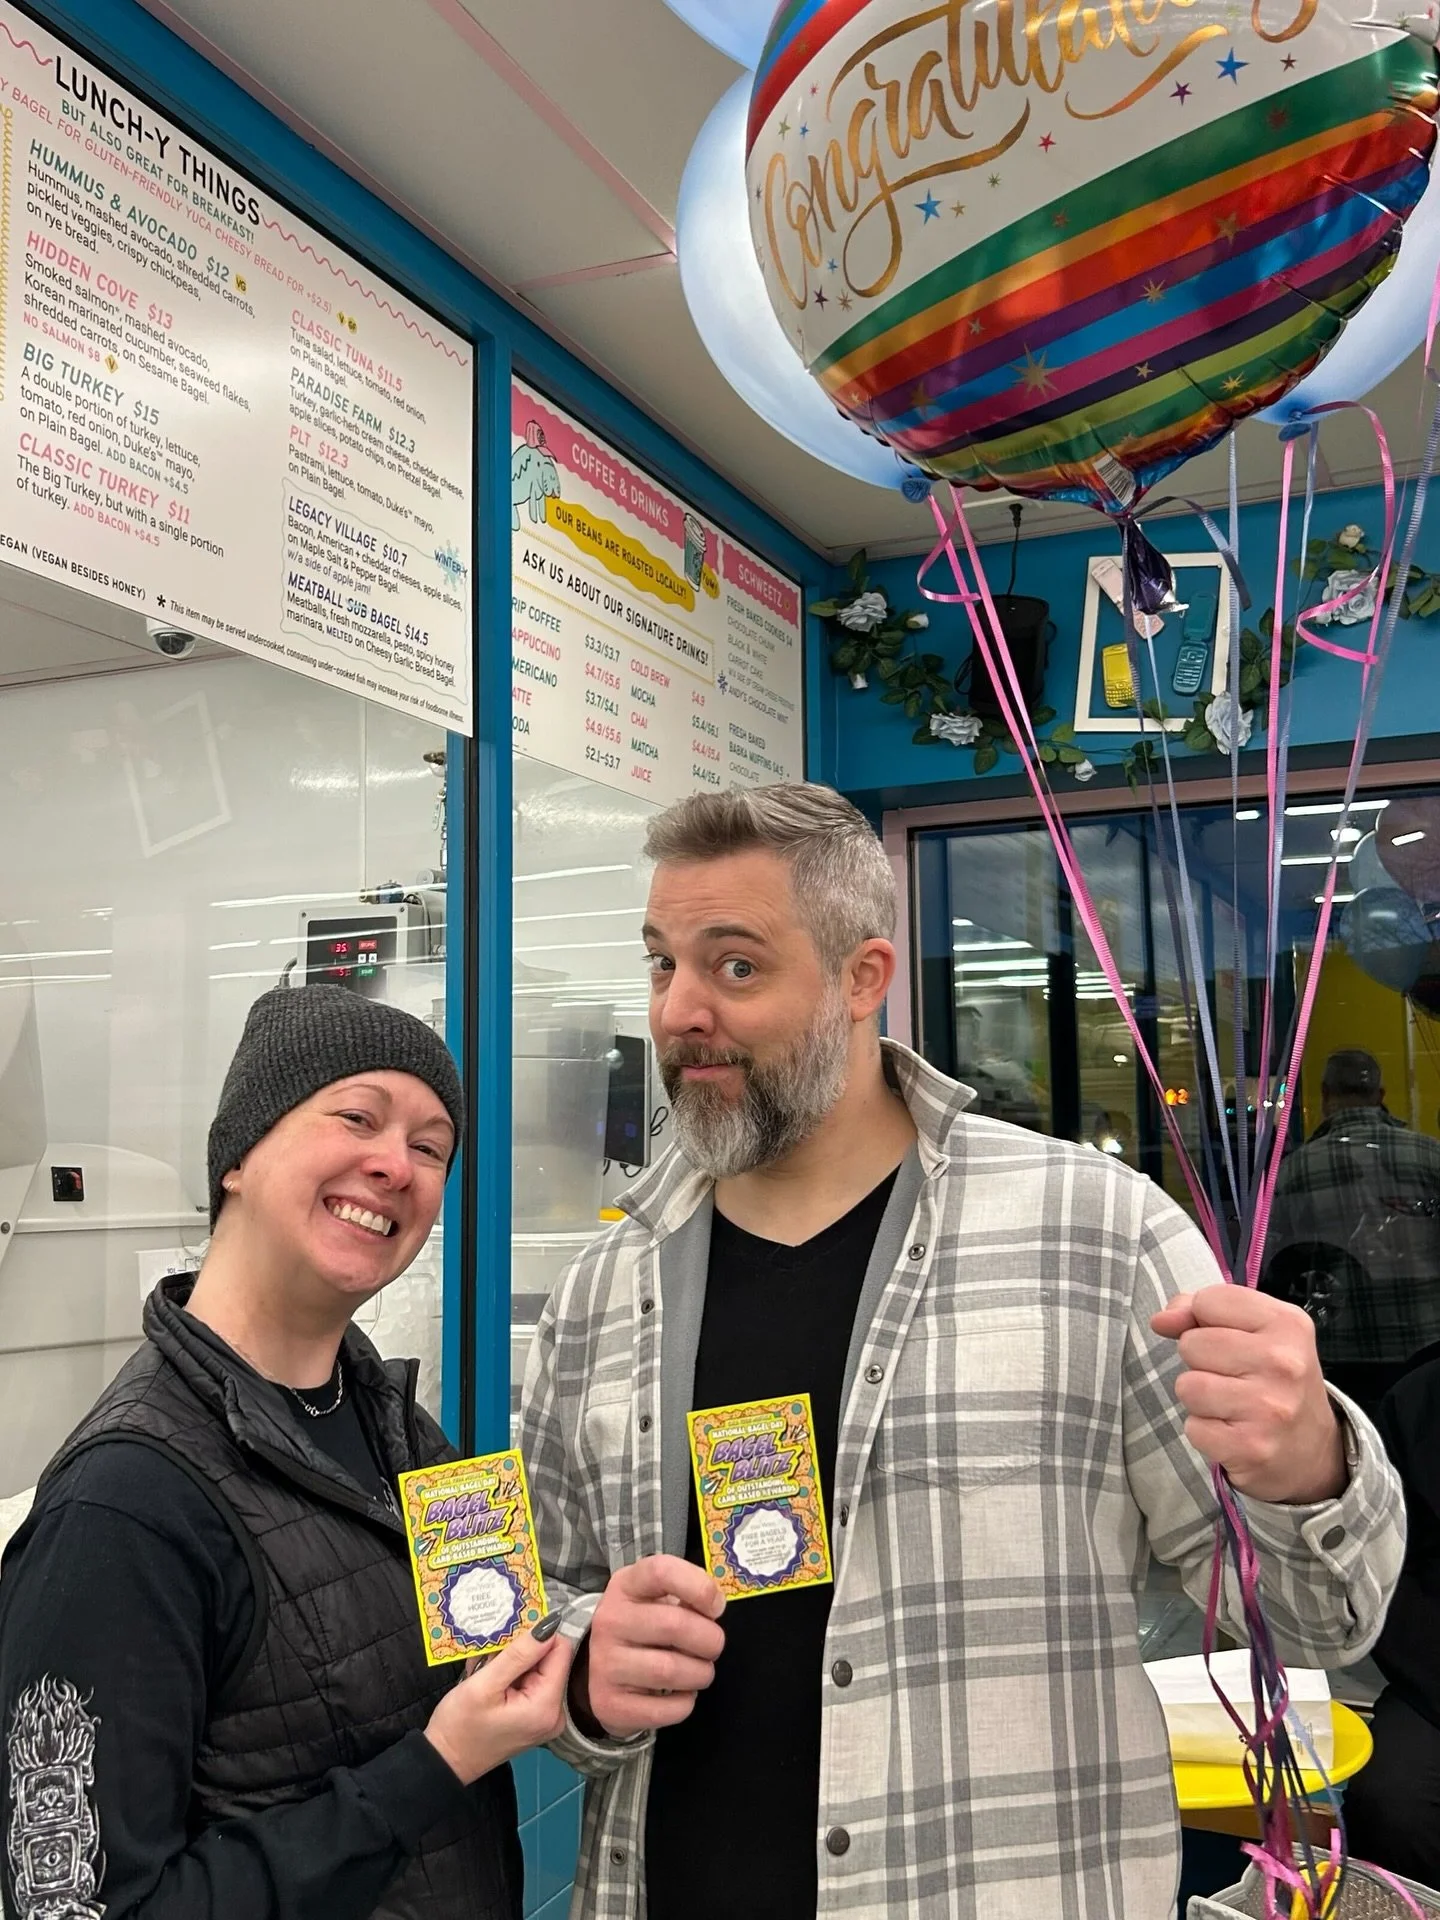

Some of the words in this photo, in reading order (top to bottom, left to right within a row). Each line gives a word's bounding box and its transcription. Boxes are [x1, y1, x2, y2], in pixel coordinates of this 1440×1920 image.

[56, 55, 170, 159] LUNCH-Y
[178, 144, 259, 225] THINGS
[61, 98, 86, 126] BUT
[89, 120, 122, 152] ALSO
[126, 145, 163, 180] GREAT
[167, 173, 189, 199] FOR
[192, 190, 254, 244] BREAKFAST!
[11, 86, 53, 125] BAGEL
[57, 117, 82, 144] FOR
[84, 137, 183, 212] GLUTEN-FRIENDLY
[185, 205, 211, 233] YUCA
[215, 227, 252, 259] CHEESY
[253, 253, 284, 281] BREAD
[286, 275, 304, 295] FOR
[26, 201, 42, 219] on
[44, 211, 62, 231] rye
[65, 220, 99, 254] bread.
[30, 138, 105, 200] HUMMUS
[109, 193, 121, 213] &
[126, 205, 197, 260] AVOCADO
[206, 256, 229, 283] $12
[27, 181, 69, 216] pickled
[70, 209, 115, 247] veggies,
[117, 239, 148, 268] crispy
[150, 260, 201, 301] chickpeas,
[28, 159, 83, 209] Hummus,
[85, 200, 128, 236] mashed
[130, 229, 175, 268] avocado,
[177, 259, 220, 295] shredded
[222, 289, 255, 319] carrots,
[24, 252, 72, 291] Smoked
[124, 313, 165, 345] mashed
[167, 338, 210, 372] avocado,
[27, 230, 91, 282] HIDDEN
[96, 273, 139, 310] COVE
[147, 303, 173, 330] $13
[23, 311, 38, 329] NO
[41, 321, 85, 354] SALMON
[87, 346, 100, 362] $8
[24, 292, 77, 332] shredded
[80, 324, 120, 357] carrots,
[122, 348, 136, 364] on
[138, 354, 178, 387] Sesame
[24, 270, 65, 306] Korean
[68, 298, 123, 339] marinated
[124, 331, 177, 371] cucumber,
[179, 362, 220, 394] seaweed
[222, 384, 250, 412] flakes,
[292, 309, 342, 352] CLASSIC
[346, 343, 374, 374] TUNA
[377, 364, 402, 392] $11.5
[21, 365, 30, 381] A
[33, 371, 72, 402] double
[74, 394, 114, 423] portion
[116, 415, 128, 429] of
[129, 420, 163, 449] turkey,
[165, 437, 200, 468] lettuce,
[23, 342, 54, 371] BIG
[61, 360, 124, 407] TURKEY
[133, 400, 159, 426] $15
[290, 366, 350, 414] PARADISE
[351, 403, 382, 434] FARM
[388, 426, 415, 454] $12.3
[19, 406, 35, 422] on
[38, 411, 67, 437] Plain
[69, 426, 103, 454] Bagel.
[106, 446, 126, 464] ADD
[129, 457, 161, 482] BACON
[163, 476, 189, 495] +$4.5
[20, 384, 65, 419] tomato,
[67, 409, 86, 427] red
[88, 420, 121, 447] onion,
[165, 458, 195, 482] mayo,
[289, 424, 311, 448] PLT
[318, 440, 349, 469] $12.3
[16, 476, 29, 491] of
[31, 481, 70, 510] turkey.
[73, 501, 95, 519] ADD
[97, 510, 131, 535] BACON
[134, 528, 160, 547] +$4.5
[17, 453, 40, 477] The
[42, 465, 61, 489] Big
[63, 474, 103, 507] Turkey,
[105, 493, 123, 514] but
[125, 505, 147, 524] with
[149, 516, 156, 528] a
[158, 520, 188, 542] single
[190, 534, 224, 557] portion
[20, 432, 93, 479] CLASSIC
[98, 467, 159, 509] TURKEY
[168, 500, 189, 525] $11
[571, 445, 615, 489] COFFEE
[619, 479, 627, 497] &
[630, 487, 669, 526] DRINKS
[288, 495, 332, 529] LEGACY
[335, 518, 377, 553] VILLAGE
[382, 543, 407, 567] $10.7
[555, 505, 573, 528] OUR
[576, 518, 603, 546] BEANS
[604, 538, 620, 557] ARE
[621, 547, 654, 578] ROASTED
[655, 570, 686, 599] LOCALLY!
[32, 546, 68, 570] (VEGAN
[70, 561, 109, 586] BESIDES
[112, 578, 146, 601] HONEY)
[288, 571, 343, 609] MEATBALL
[346, 597, 367, 619] SUB
[370, 608, 401, 635] BAGEL
[404, 623, 428, 646] $14.5
[522, 549, 546, 575] ASK
[549, 562, 564, 584] US
[566, 573, 601, 604] ABOUT
[603, 594, 623, 618] OUR
[625, 607, 674, 647] SIGNATURE
[676, 636, 708, 666] DRINKS!
[738, 565, 783, 607] SCHWEETZ
[528, 605, 561, 633] COFFEE
[585, 634, 620, 662] $3.3/$3.7
[585, 661, 620, 690] $4.7/$5.6
[585, 689, 619, 716] $3.7/$4.1
[630, 658, 649, 678] COLD
[650, 668, 670, 688] BREW
[630, 685, 656, 707] MOCHA
[585, 716, 621, 744] $4.9/$5.6
[630, 711, 648, 729] CHAI
[631, 737, 658, 760] MATCHA
[631, 765, 652, 783] JUICE
[713, 1433, 777, 1465] BAGEL
[731, 1450, 796, 1482] BLITZ
[425, 1489, 490, 1525] BAGEL
[445, 1507, 511, 1543] BLITZ
